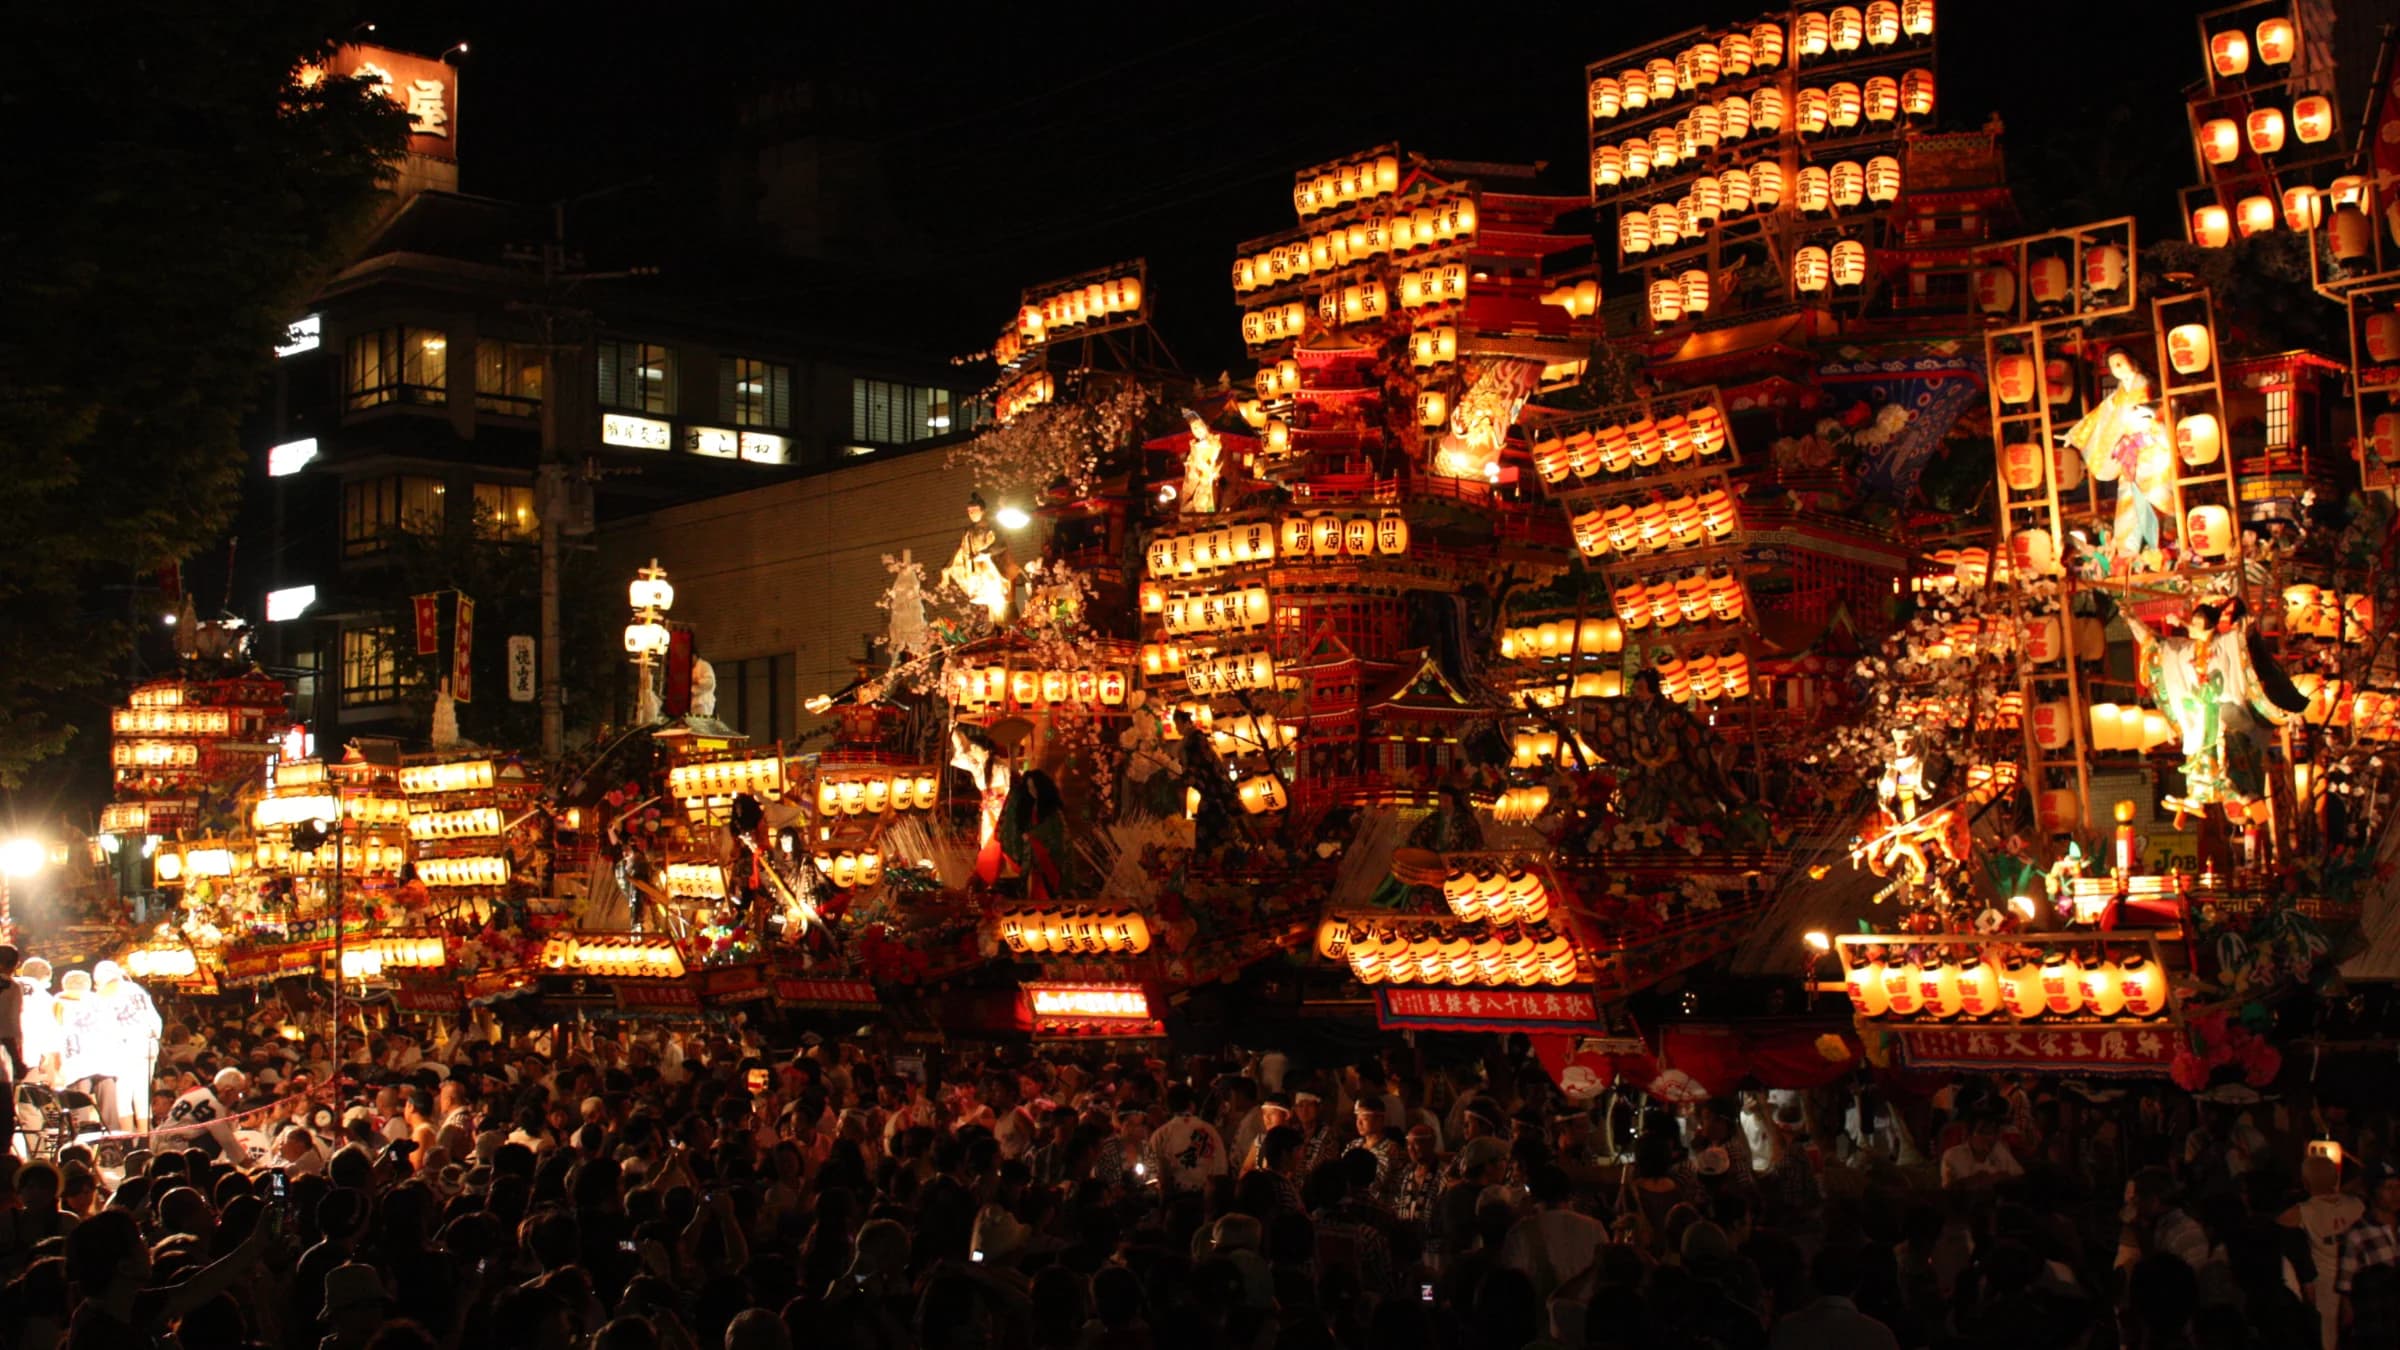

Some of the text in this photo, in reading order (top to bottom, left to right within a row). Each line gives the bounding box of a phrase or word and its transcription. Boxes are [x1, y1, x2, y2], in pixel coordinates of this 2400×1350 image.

[1295, 523, 1309, 551] 川原
[1325, 516, 1340, 549] 川原
[1349, 525, 1365, 550] 川原
[1382, 520, 1397, 548] 川原
